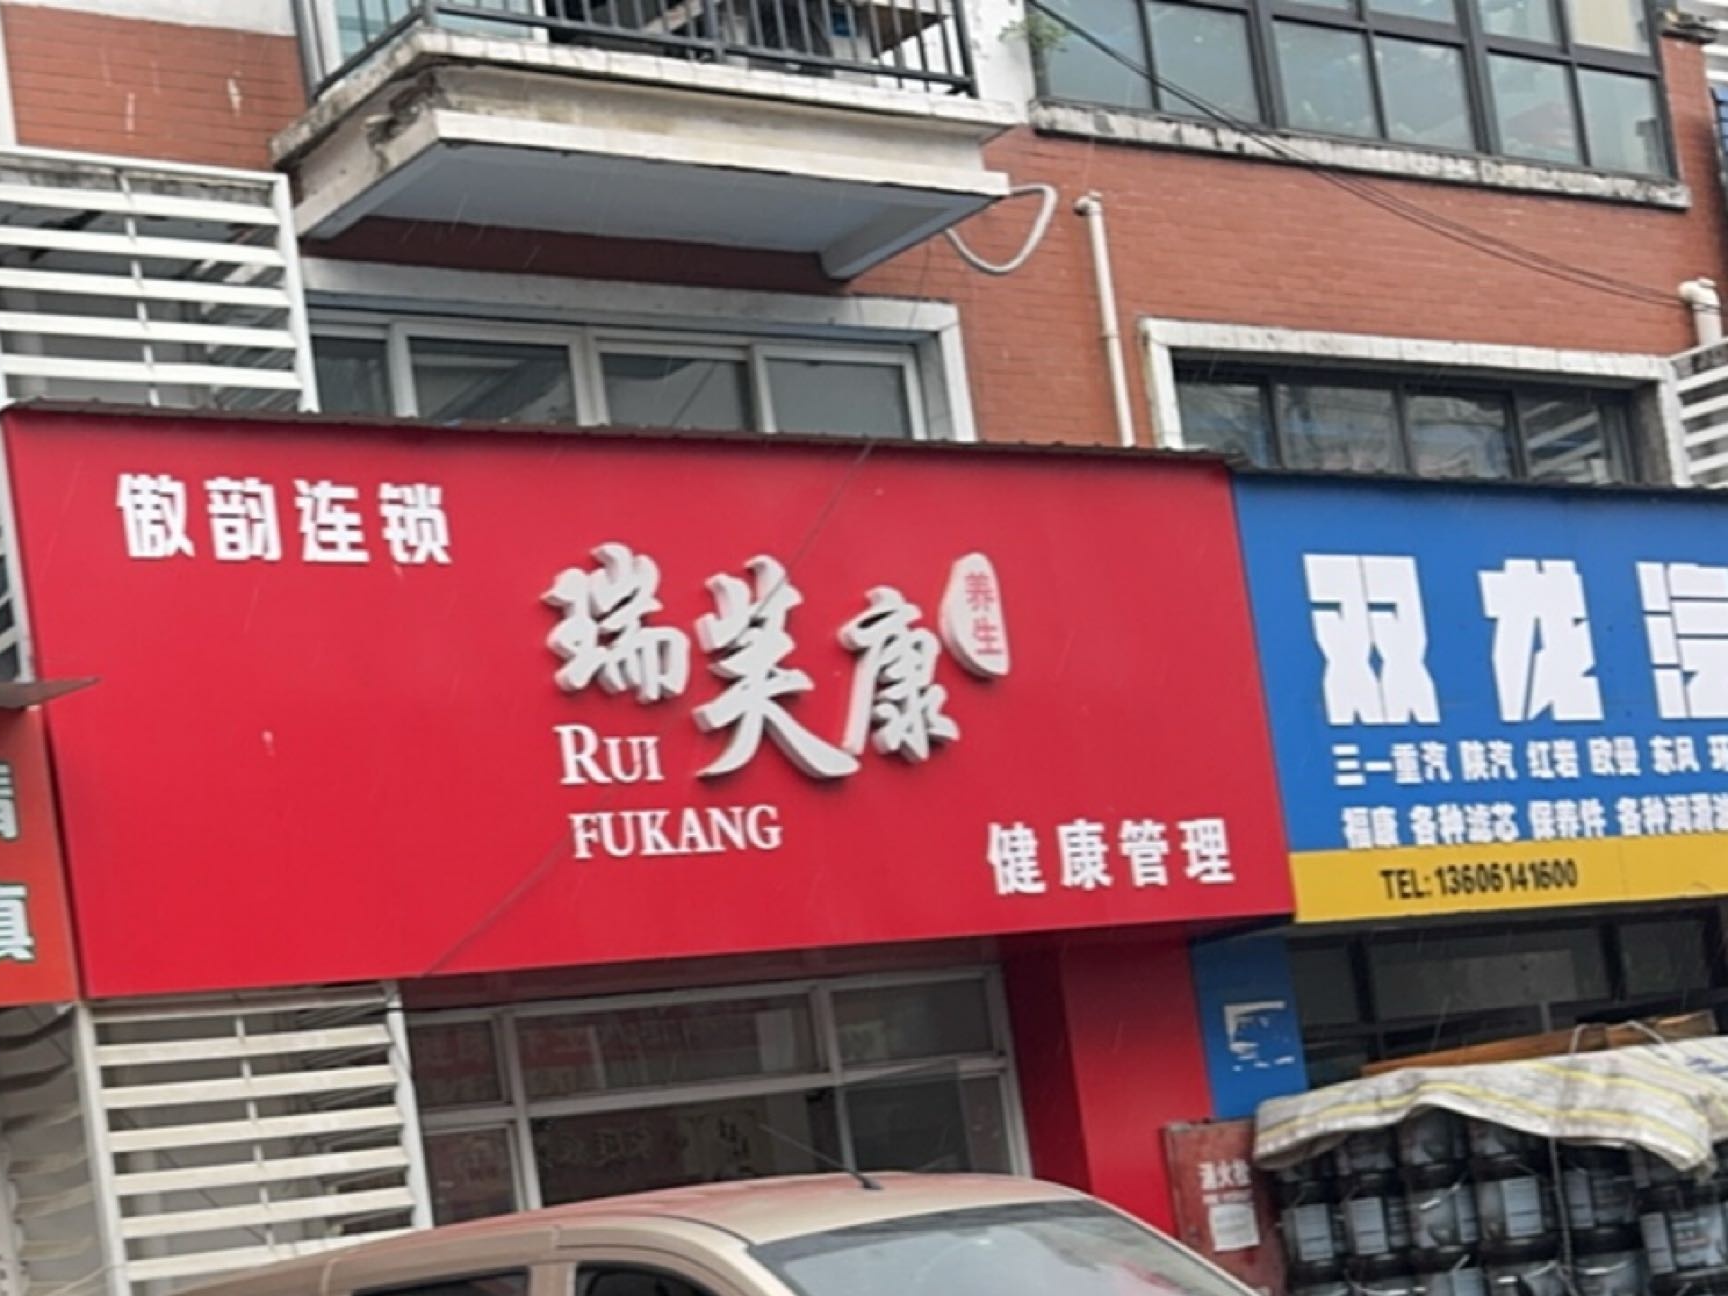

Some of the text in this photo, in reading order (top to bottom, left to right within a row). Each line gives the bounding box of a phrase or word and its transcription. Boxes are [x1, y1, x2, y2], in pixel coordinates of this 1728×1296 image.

[115, 474, 452, 564] 傲韵连锁
[964, 571, 1002, 655] 养生
[1649, 735, 1701, 774] 东风
[568, 804, 783, 860] FUKANG
[986, 817, 1235, 895] 健康管理
